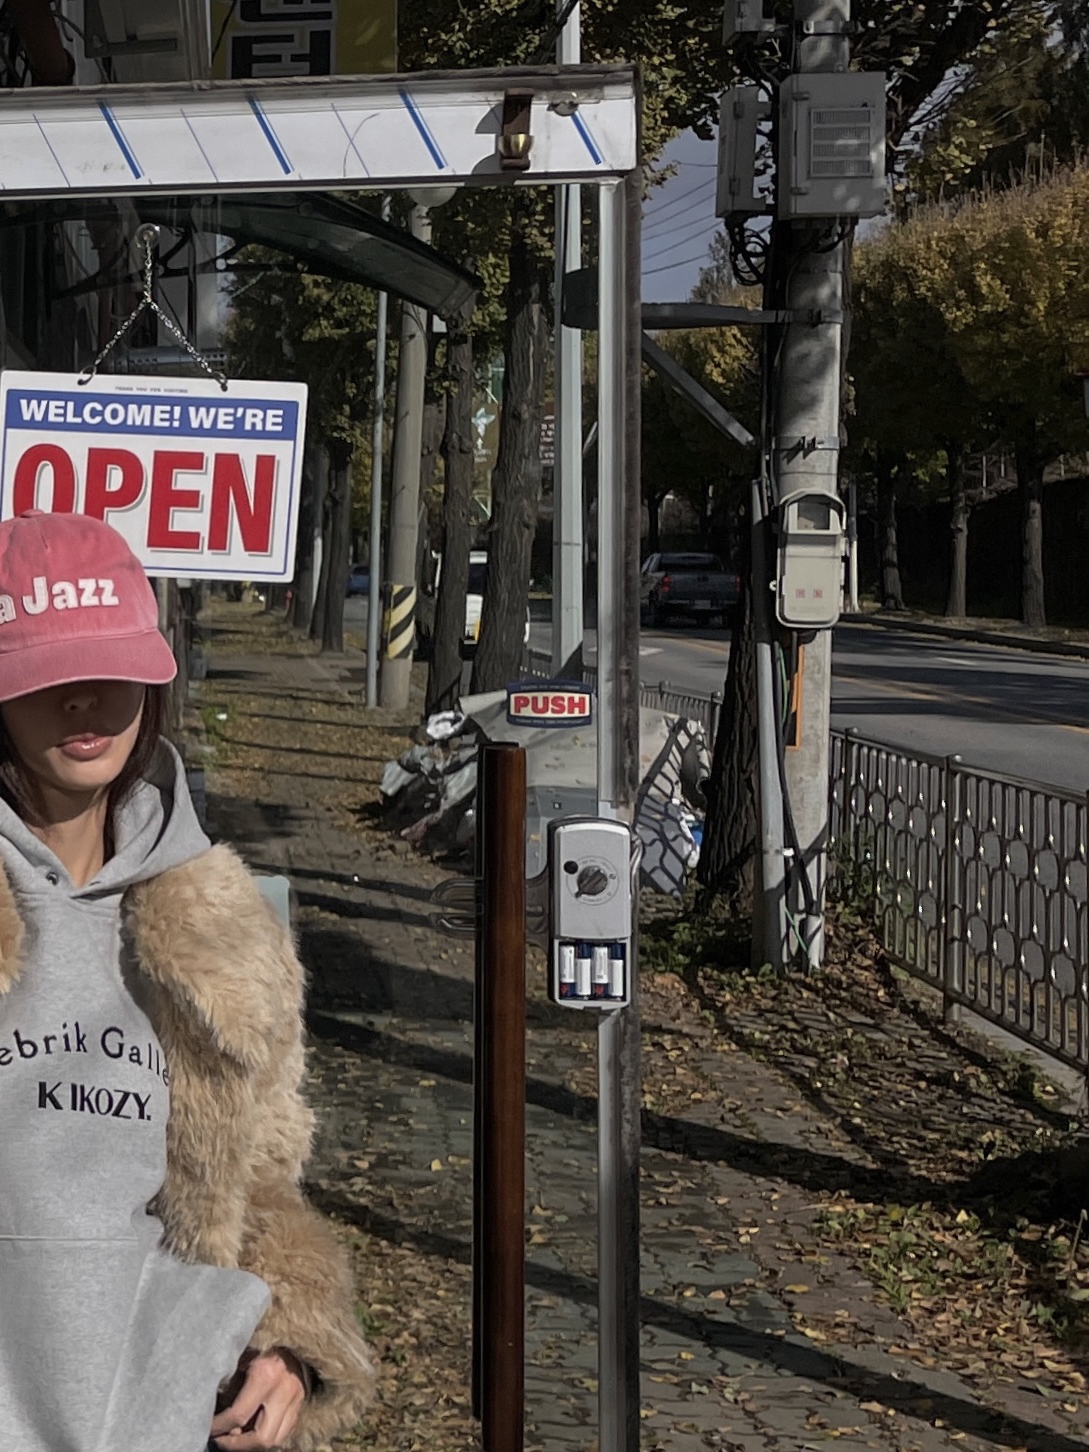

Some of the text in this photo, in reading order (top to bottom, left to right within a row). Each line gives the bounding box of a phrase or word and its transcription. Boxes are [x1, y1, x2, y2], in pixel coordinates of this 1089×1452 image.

[20, 398, 284, 432] WELCOME! WE'RE
[12, 443, 278, 554] OPEN
[22, 576, 119, 615] Jazz
[513, 695, 586, 715] PUSH
